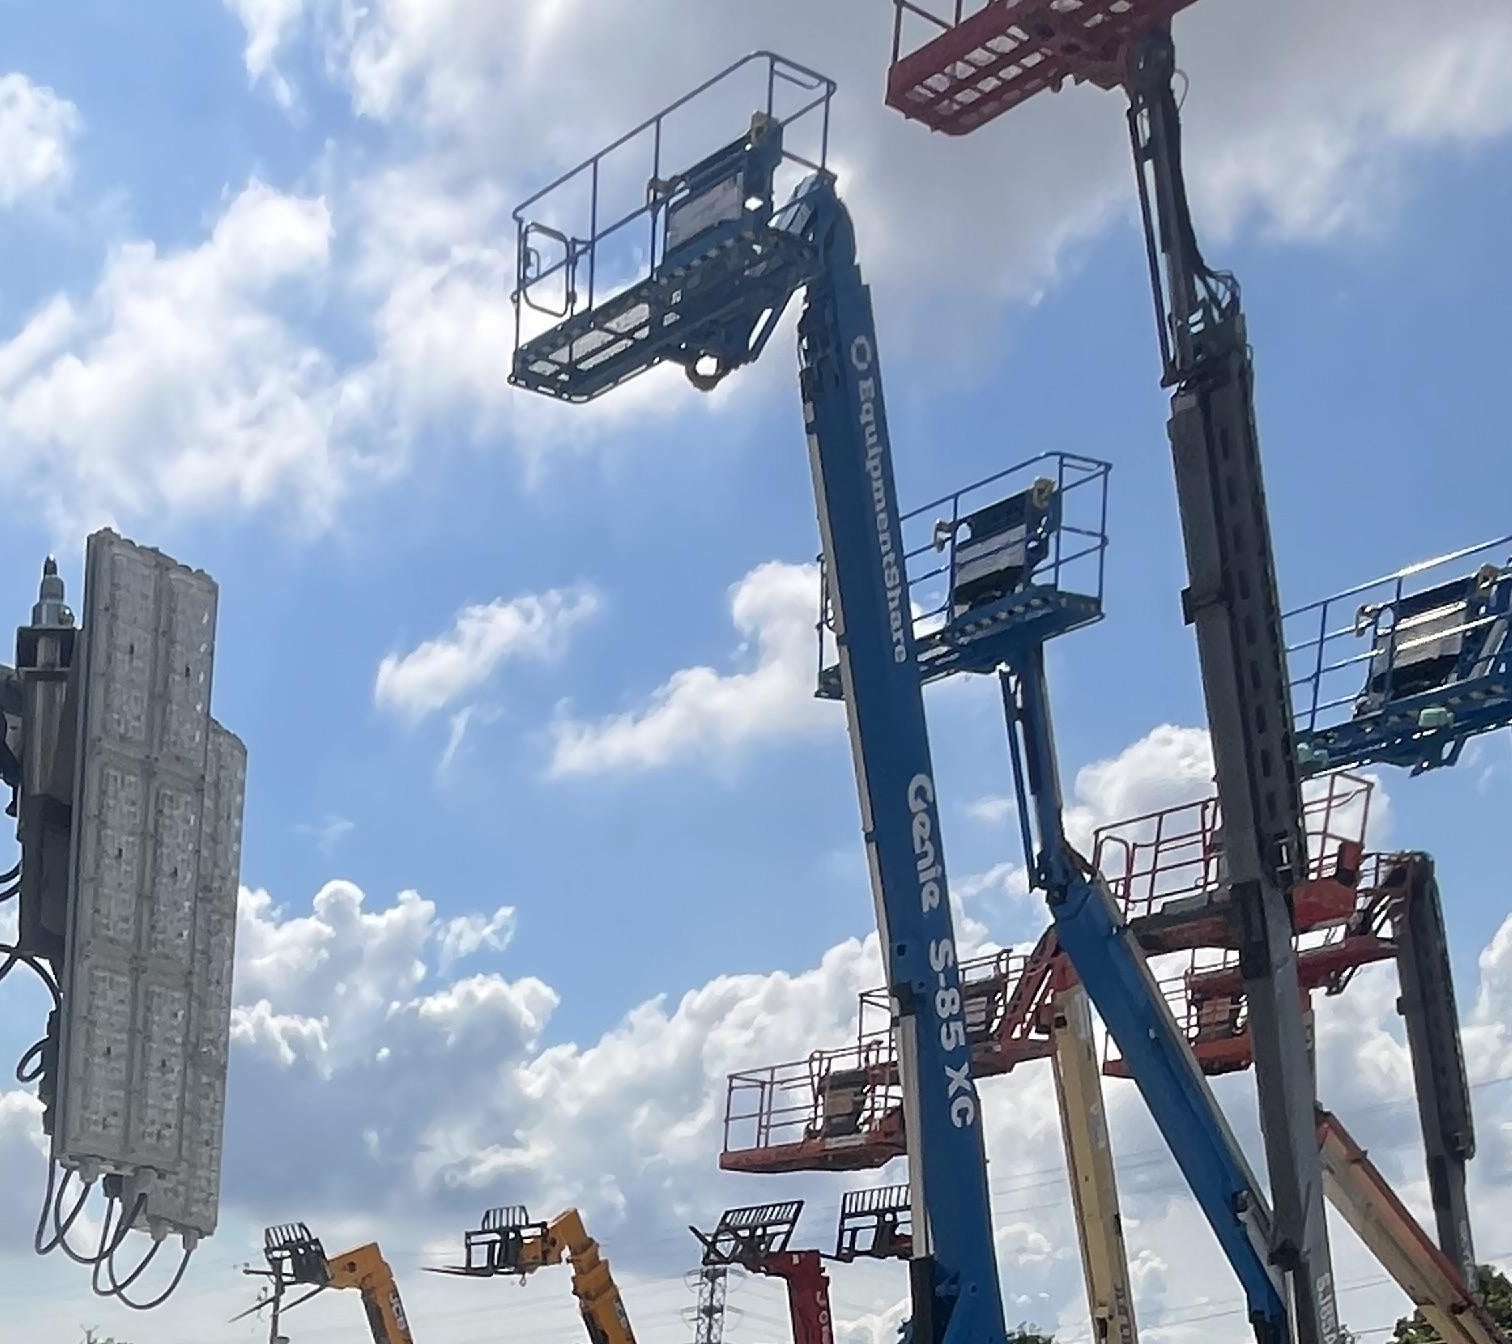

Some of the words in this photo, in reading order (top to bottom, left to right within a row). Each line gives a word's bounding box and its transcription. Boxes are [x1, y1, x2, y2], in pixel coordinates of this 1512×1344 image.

[858, 377, 908, 663] EquipmentShare
[907, 773, 942, 913] Genie
[928, 937, 966, 1051] S-85
[944, 1061, 975, 1128] XC
